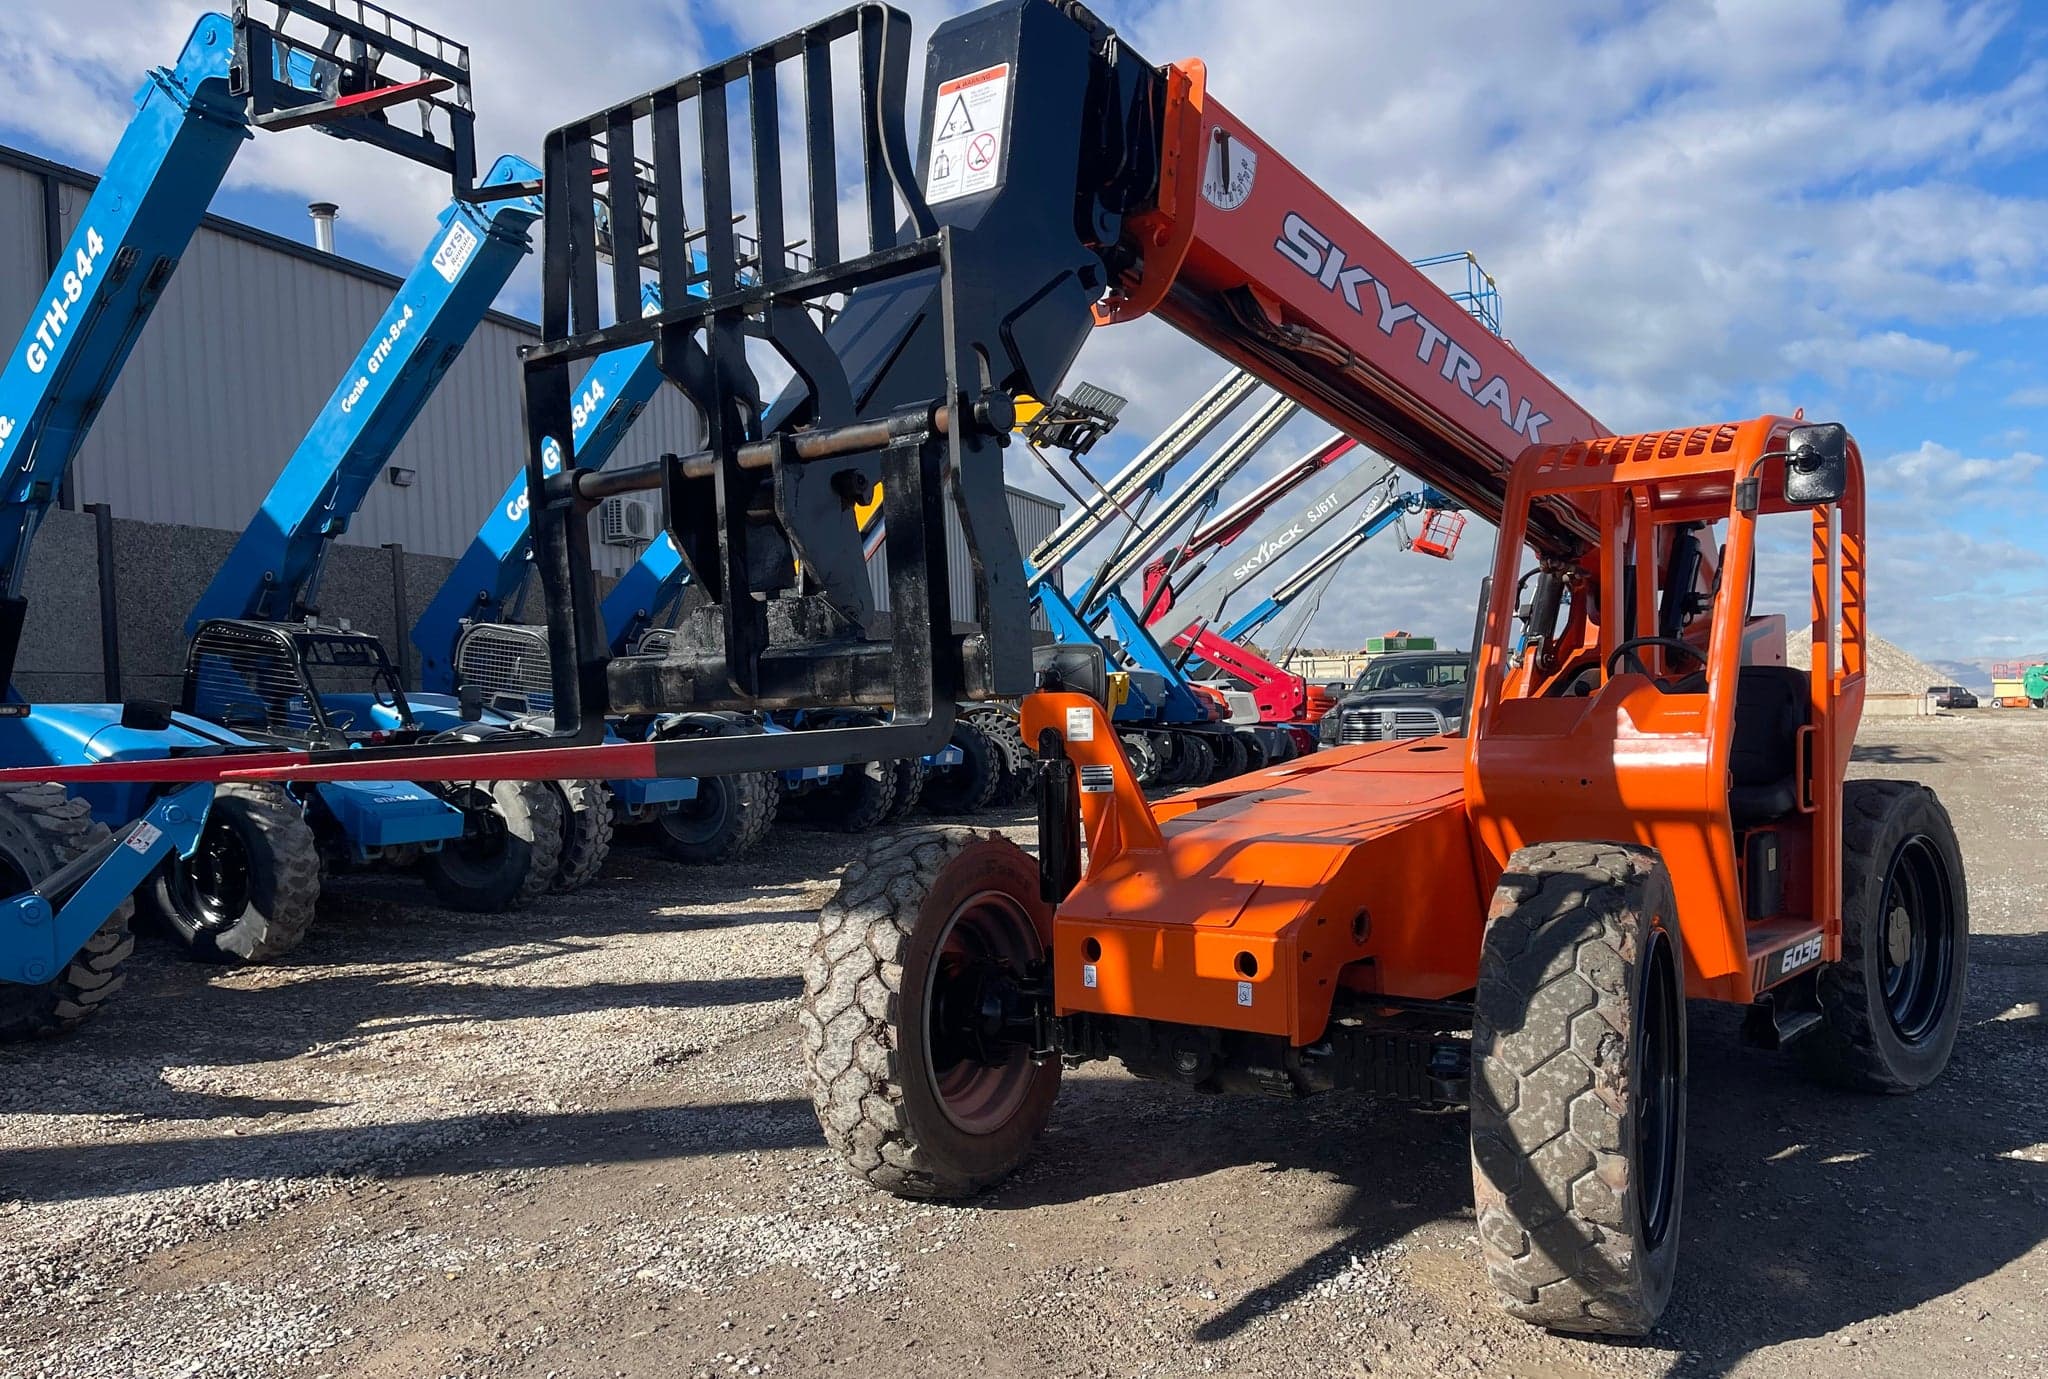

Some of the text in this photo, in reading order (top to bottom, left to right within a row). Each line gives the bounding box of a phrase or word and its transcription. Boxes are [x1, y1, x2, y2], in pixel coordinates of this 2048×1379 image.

[434, 224, 466, 266] Versi
[450, 235, 471, 266] Rentals
[26, 226, 105, 374] GTH-844
[1274, 211, 1552, 444] SKYTRAK
[341, 303, 414, 413] Genie GTH-844
[1233, 492, 1340, 581] SKYJACK SJ61T
[1781, 935, 1822, 974] 6036
